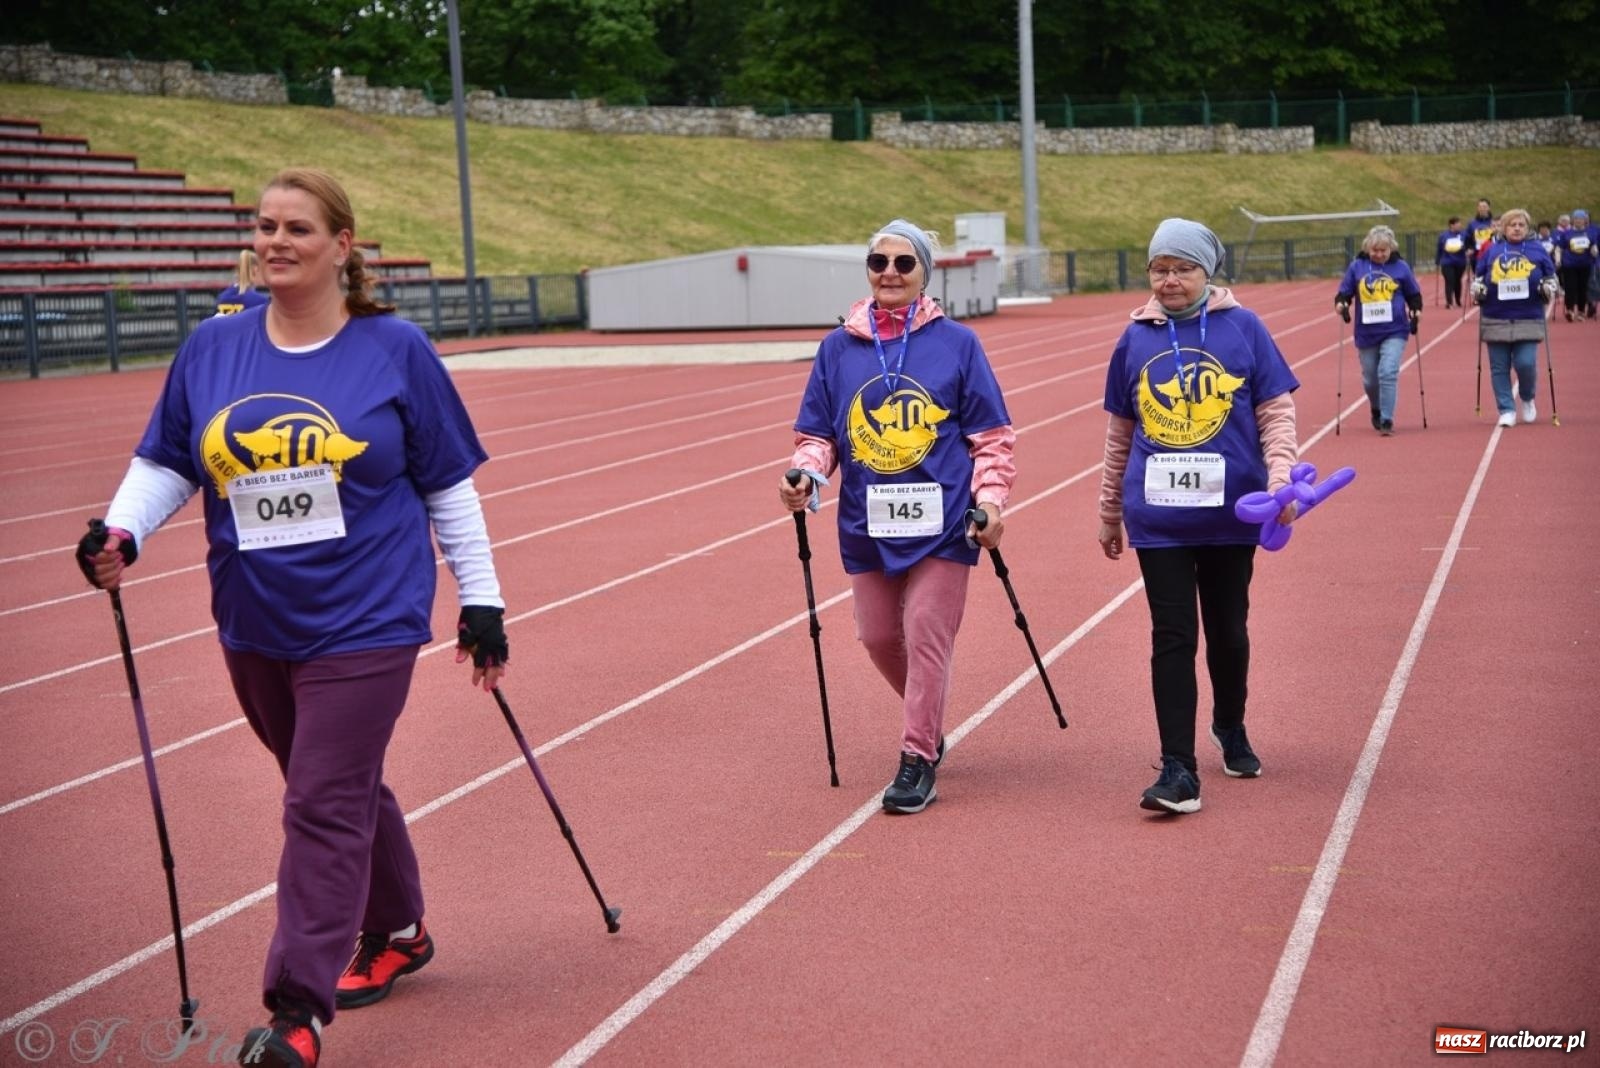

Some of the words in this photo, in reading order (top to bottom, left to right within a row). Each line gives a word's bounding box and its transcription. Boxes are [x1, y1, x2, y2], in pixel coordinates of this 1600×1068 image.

[894, 399, 925, 430] 10
[1142, 399, 1191, 433] RACIBORSKI
[273, 424, 326, 467] 10
[855, 424, 896, 459] RACIBORSKI
[235, 480, 242, 488] X
[244, 475, 267, 487] BIEG
[269, 473, 288, 483] BEZ
[290, 468, 326, 481] BARIER
[1168, 471, 1201, 489] 141
[256, 492, 313, 522] 049
[888, 502, 924, 520] 145
